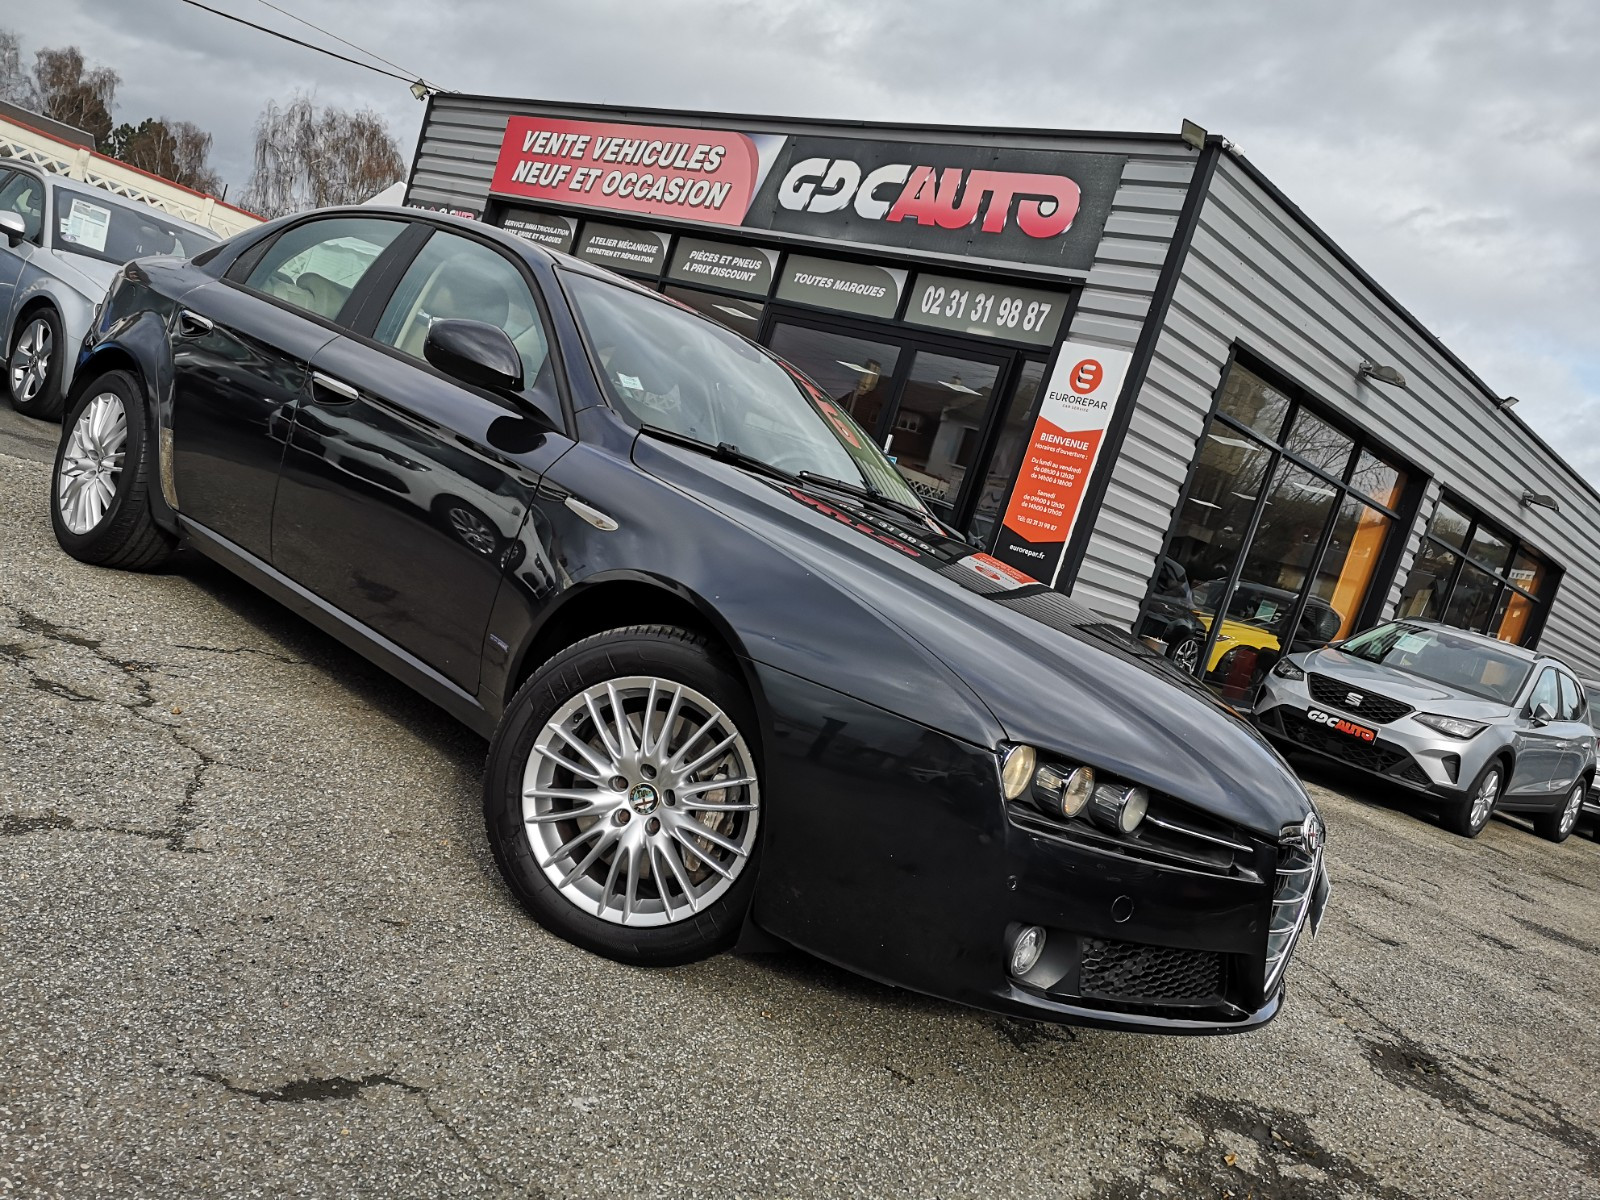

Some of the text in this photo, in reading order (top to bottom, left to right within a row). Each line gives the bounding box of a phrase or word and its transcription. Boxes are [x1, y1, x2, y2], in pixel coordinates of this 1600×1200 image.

[521, 130, 726, 172] VENTE VEHICULES
[511, 160, 732, 209] NEUF ET OCCASION
[778, 158, 1081, 238] GDCAUTO
[504, 219, 570, 236] SERVICE IMMATRICULATION
[539, 234, 562, 244] PLAQUES
[589, 236, 658, 254] ATELIER MÉCANIQUE
[586, 246, 614, 257] ENTRETIEN
[620, 252, 654, 264] RÉPARATION
[689, 250, 762, 270] PIÈCES ET PNEUS
[682, 262, 756, 282] A PRIX DISCOUNT
[793, 272, 886, 298] TOUTES MARQUES
[921, 286, 1051, 332] 02 31 31 98 87
[1048, 392, 1108, 410] EUROREPAR
[1034, 442, 1056, 453] Horaires
[1040, 432, 1090, 450] BIENVENUE
[1039, 458, 1052, 466] lundi
[1059, 464, 1082, 474] vendredi
[1037, 490, 1056, 498] Samedi
[1010, 544, 1046, 560] eurorepar.fr
[1307, 710, 1375, 742] GDCAUTO
